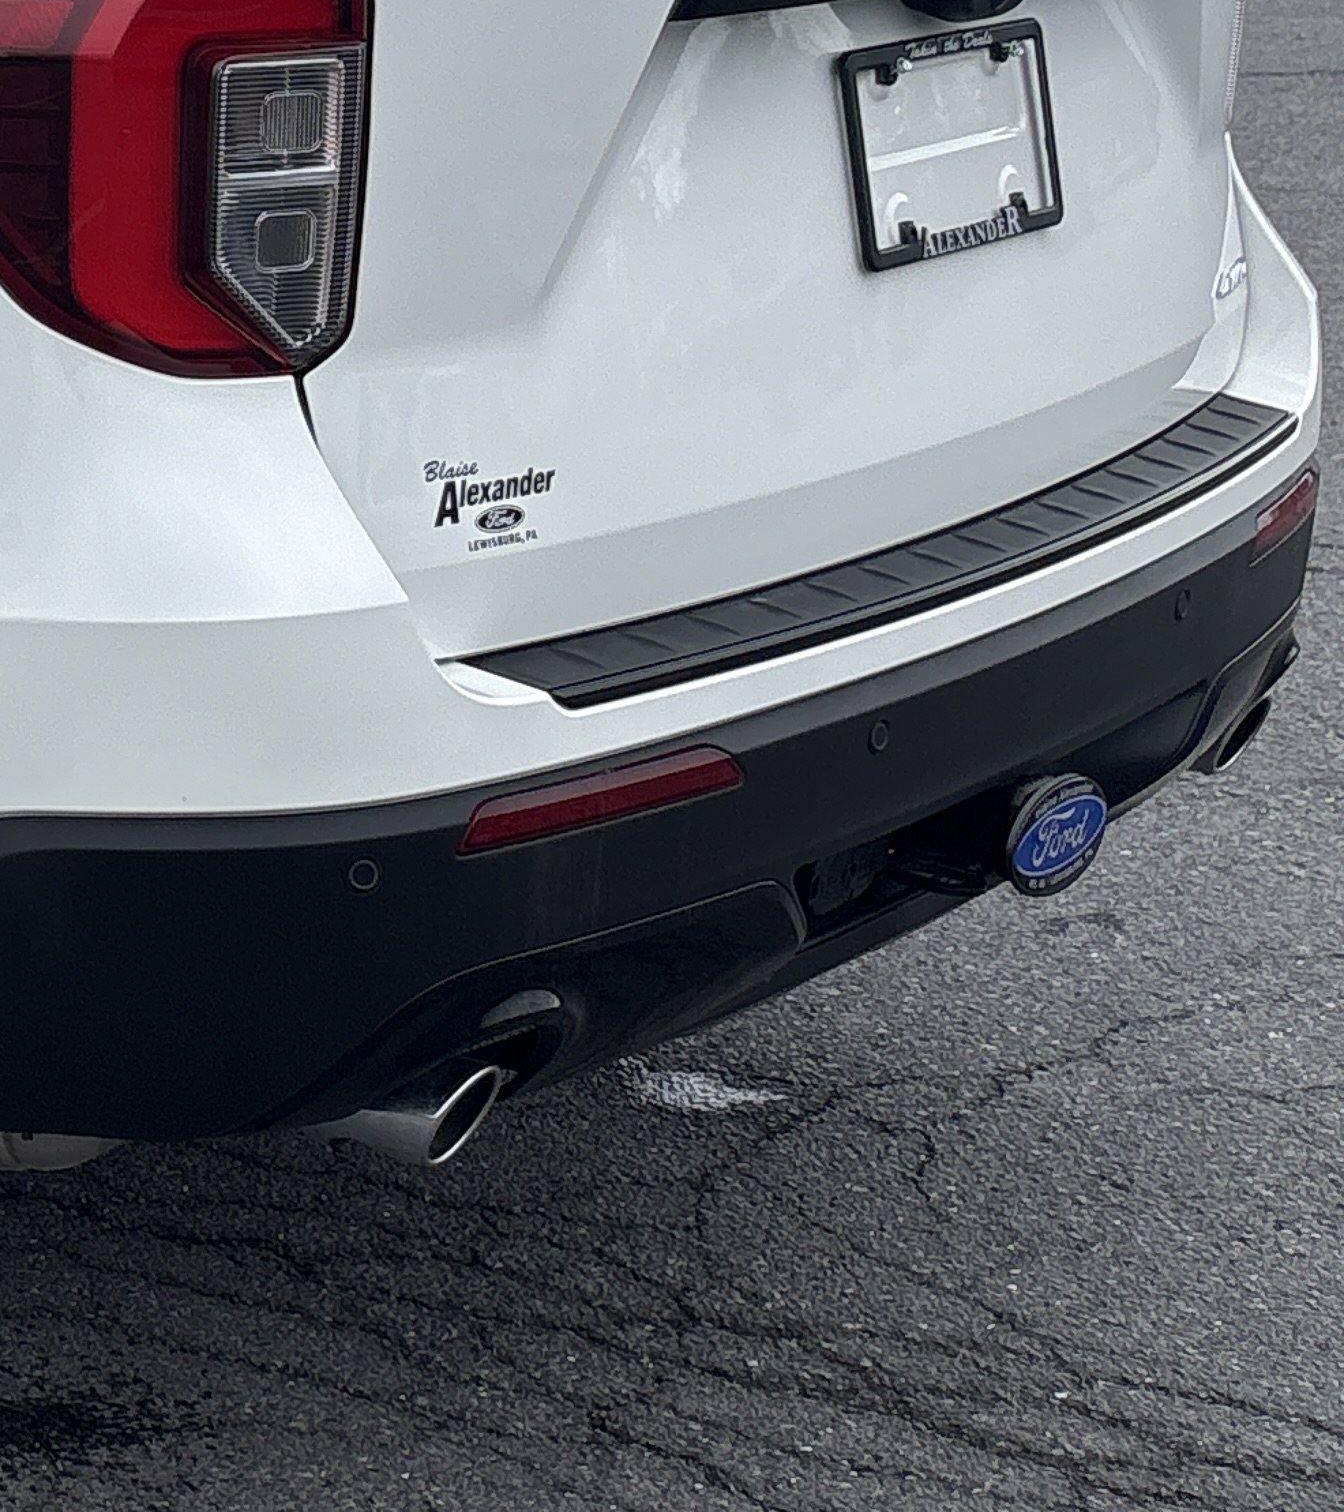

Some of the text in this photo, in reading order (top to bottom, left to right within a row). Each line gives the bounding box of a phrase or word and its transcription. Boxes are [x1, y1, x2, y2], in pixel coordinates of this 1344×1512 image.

[922, 205, 1023, 258] ALEXANDER
[423, 460, 479, 483] Blaise
[433, 467, 556, 528] Alexander
[526, 529, 538, 542] PA
[1031, 806, 1090, 868] Ford
